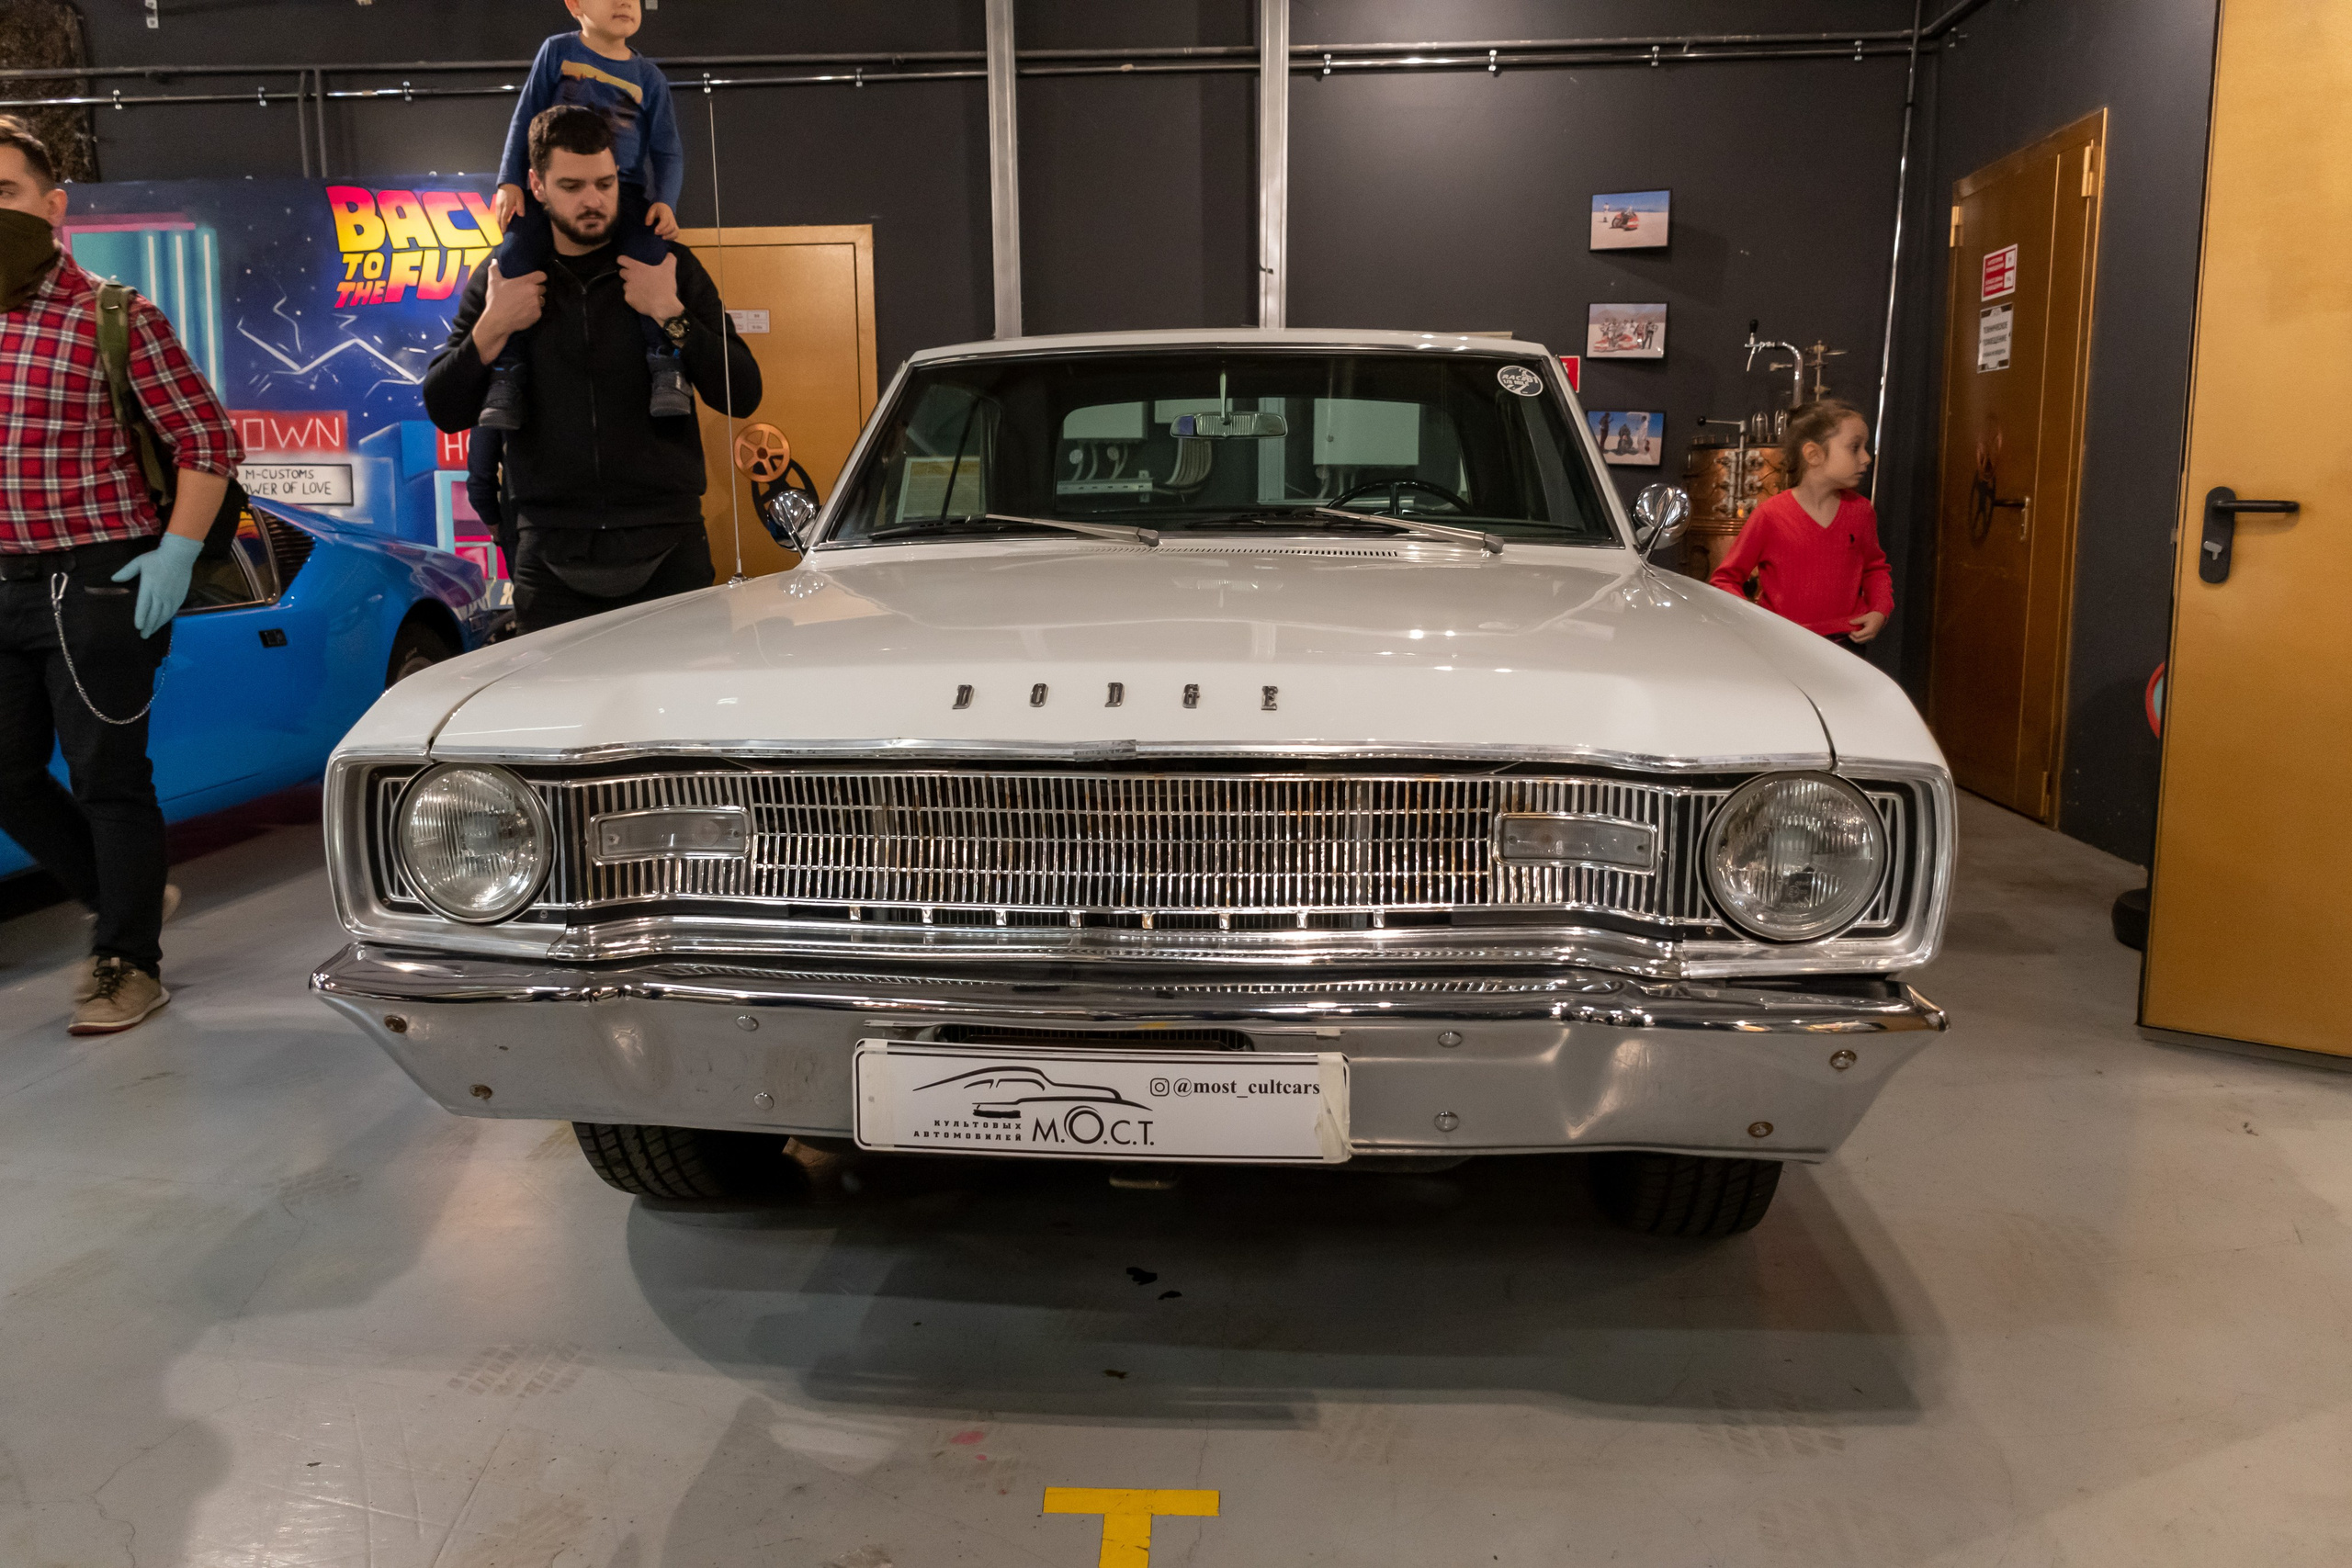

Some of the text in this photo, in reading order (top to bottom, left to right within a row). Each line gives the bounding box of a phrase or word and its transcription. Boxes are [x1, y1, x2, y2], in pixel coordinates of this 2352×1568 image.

[342, 252, 385, 281] TO
[334, 280, 388, 309] THE
[244, 468, 314, 479] M-CUSTOMS
[282, 480, 298, 494] OF
[302, 479, 333, 495] LOVE
[952, 682, 1279, 711] DODGE
[1172, 1077, 1321, 1099] @most_cultcars
[933, 1120, 1022, 1130] КУЛЬТОВЫХ
[913, 1130, 1022, 1141] АВТОМОБИЛЕЙ
